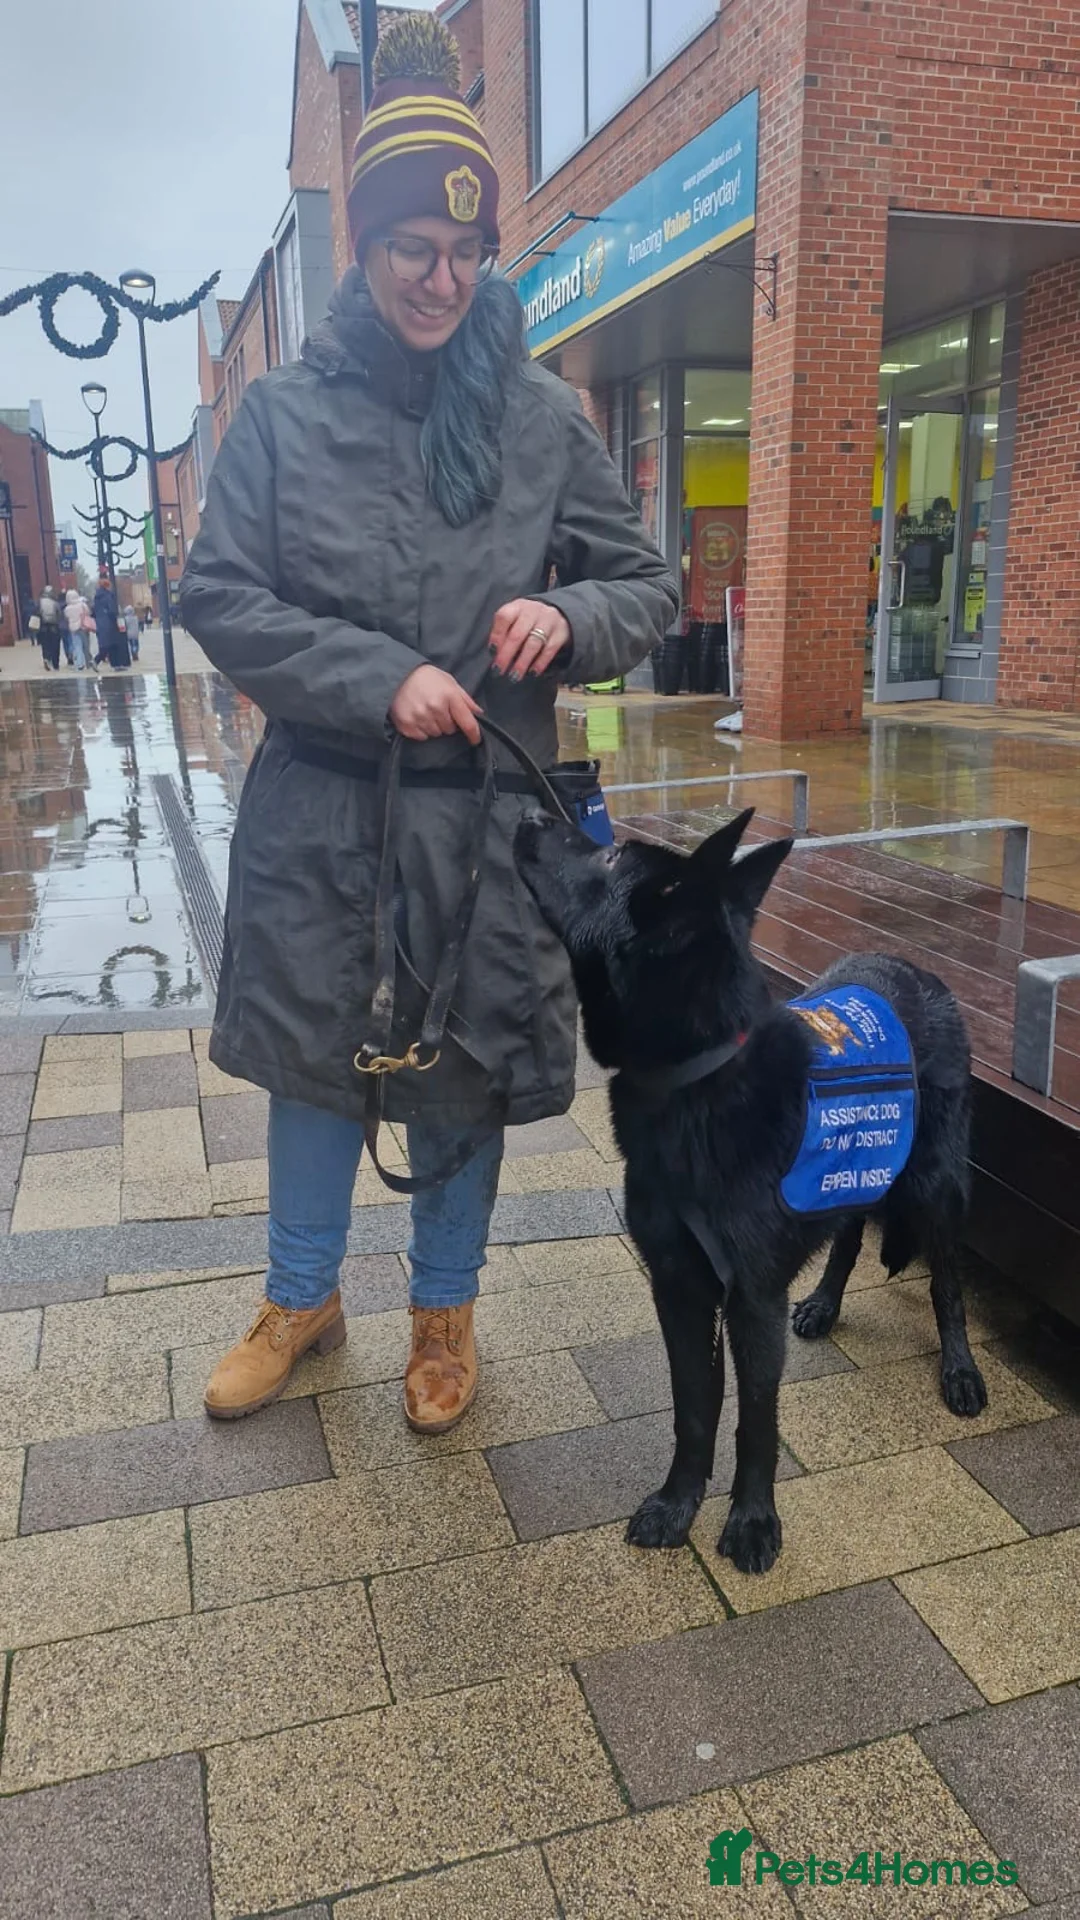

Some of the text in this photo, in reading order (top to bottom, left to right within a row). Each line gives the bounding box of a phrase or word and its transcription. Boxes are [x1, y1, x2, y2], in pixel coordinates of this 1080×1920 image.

[628, 169, 741, 267] Amazing Value Everyday!
[523, 256, 580, 331] undland
[881, 1104, 900, 1120] DOG
[856, 1129, 898, 1148] DISTRACT
[861, 1168, 892, 1188] INSIDE
